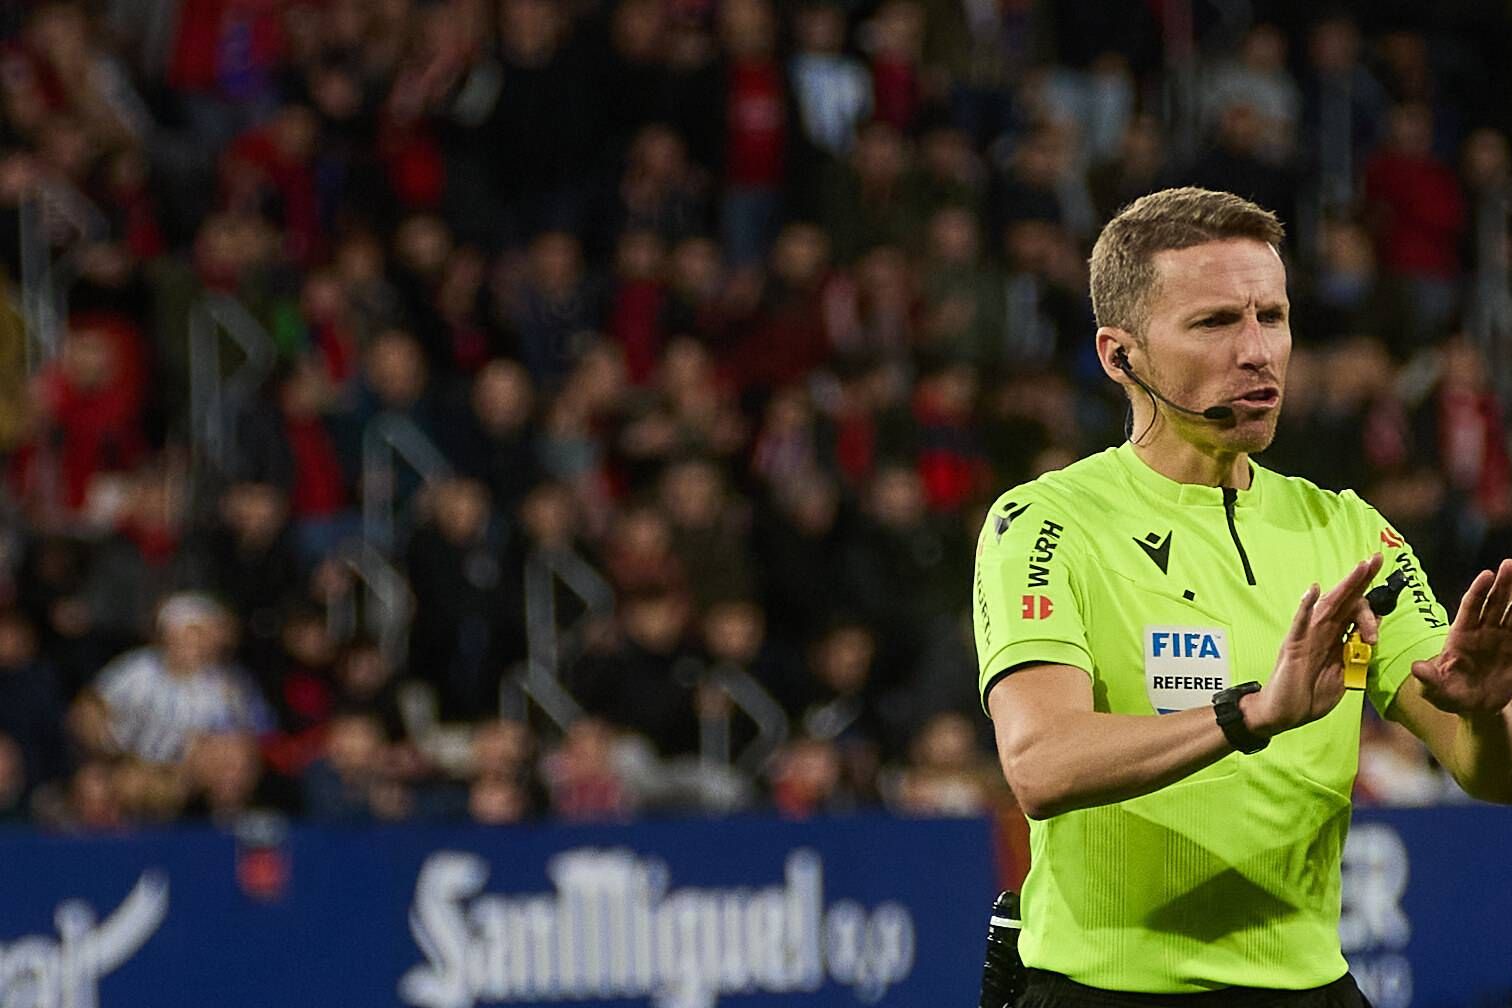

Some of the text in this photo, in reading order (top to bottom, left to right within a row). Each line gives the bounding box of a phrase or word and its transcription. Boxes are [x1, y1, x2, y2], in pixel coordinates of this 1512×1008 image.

[1027, 519, 1064, 588] WÜRH
[1152, 632, 1221, 658] FIFA
[1153, 676, 1224, 691] REFEREE
